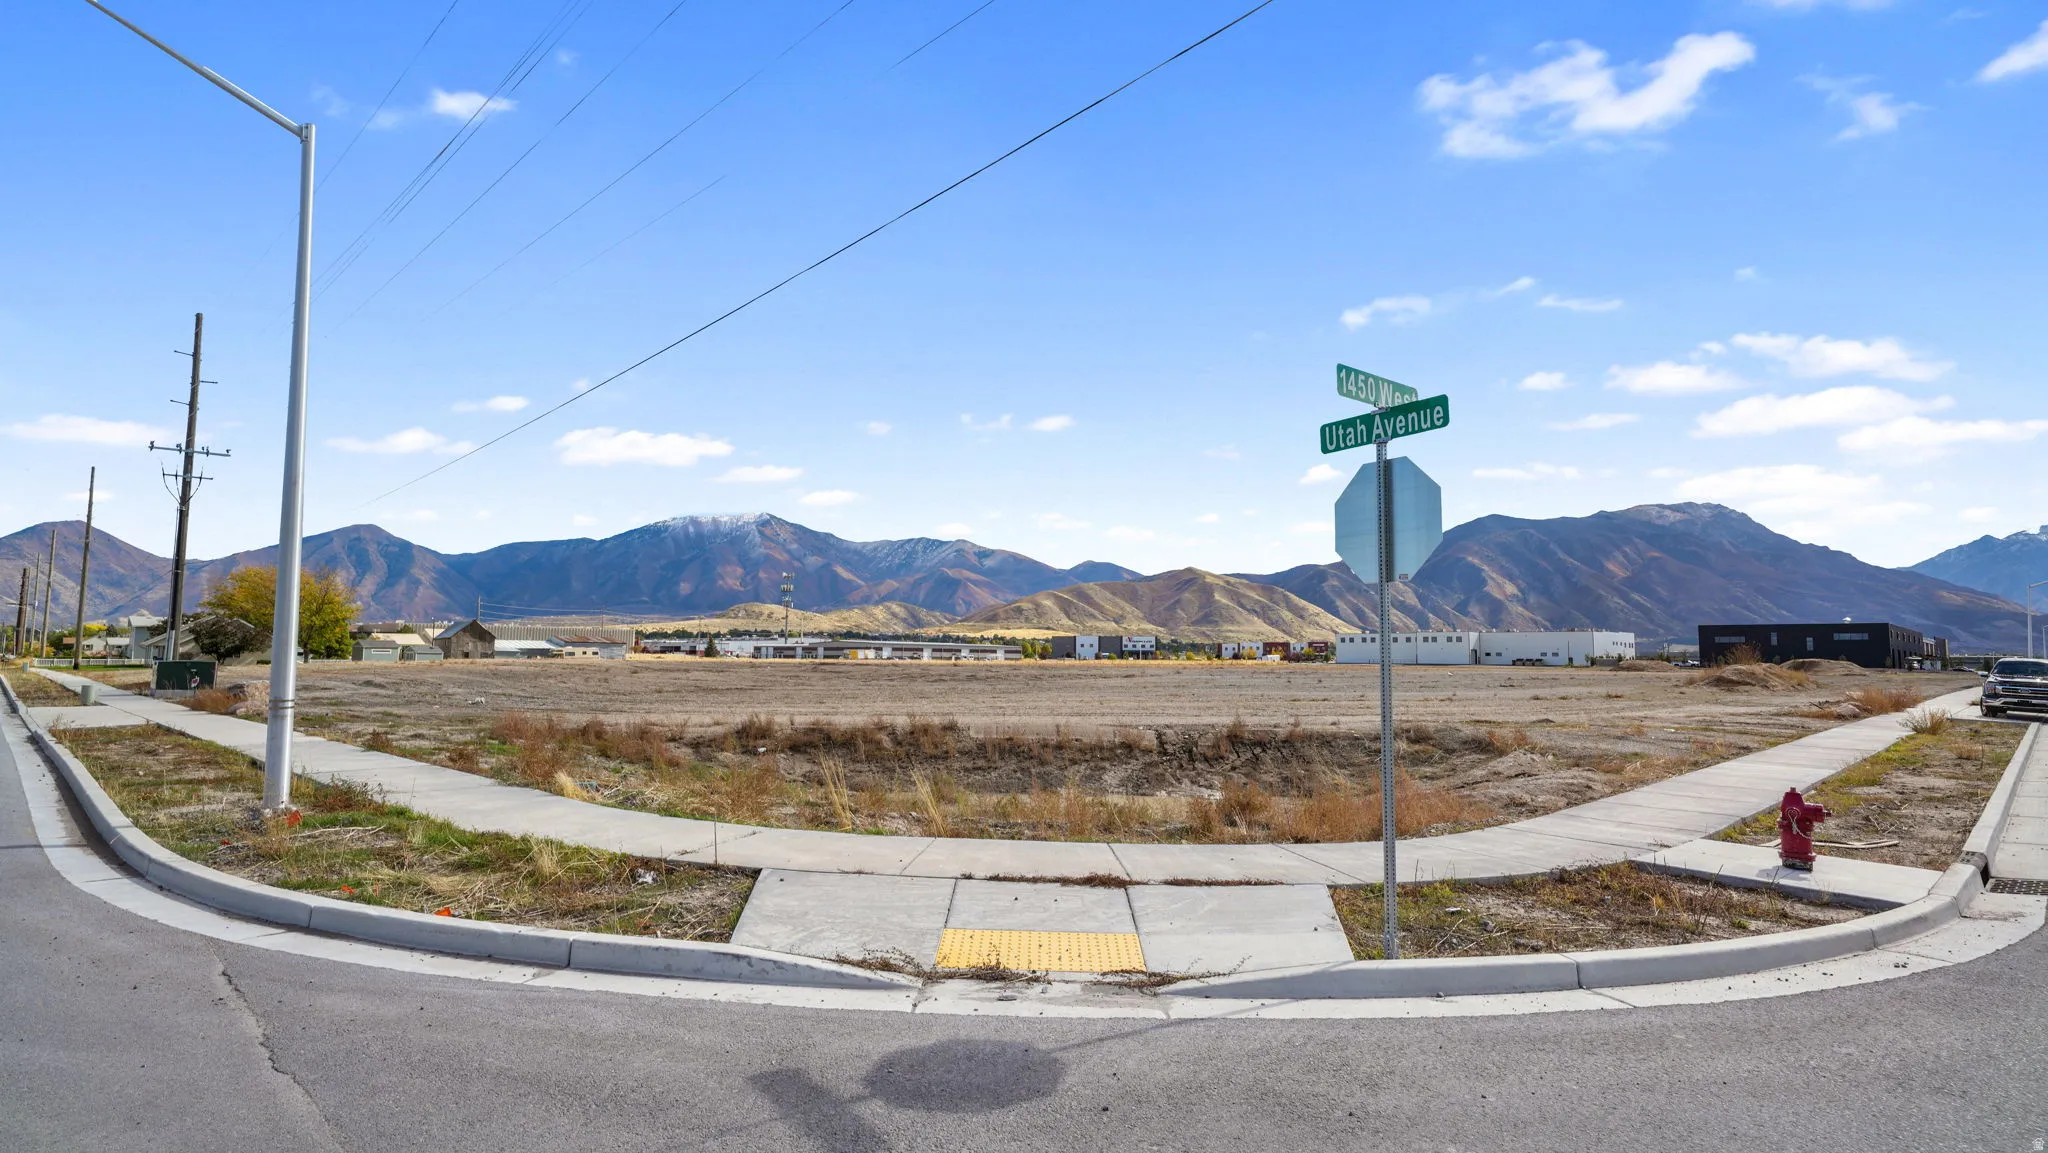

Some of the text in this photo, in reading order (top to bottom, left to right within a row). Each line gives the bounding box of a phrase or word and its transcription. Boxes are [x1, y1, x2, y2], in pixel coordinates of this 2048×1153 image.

[1340, 368, 1375, 402] 1450
[1325, 405, 1444, 451] Utah Avenue
